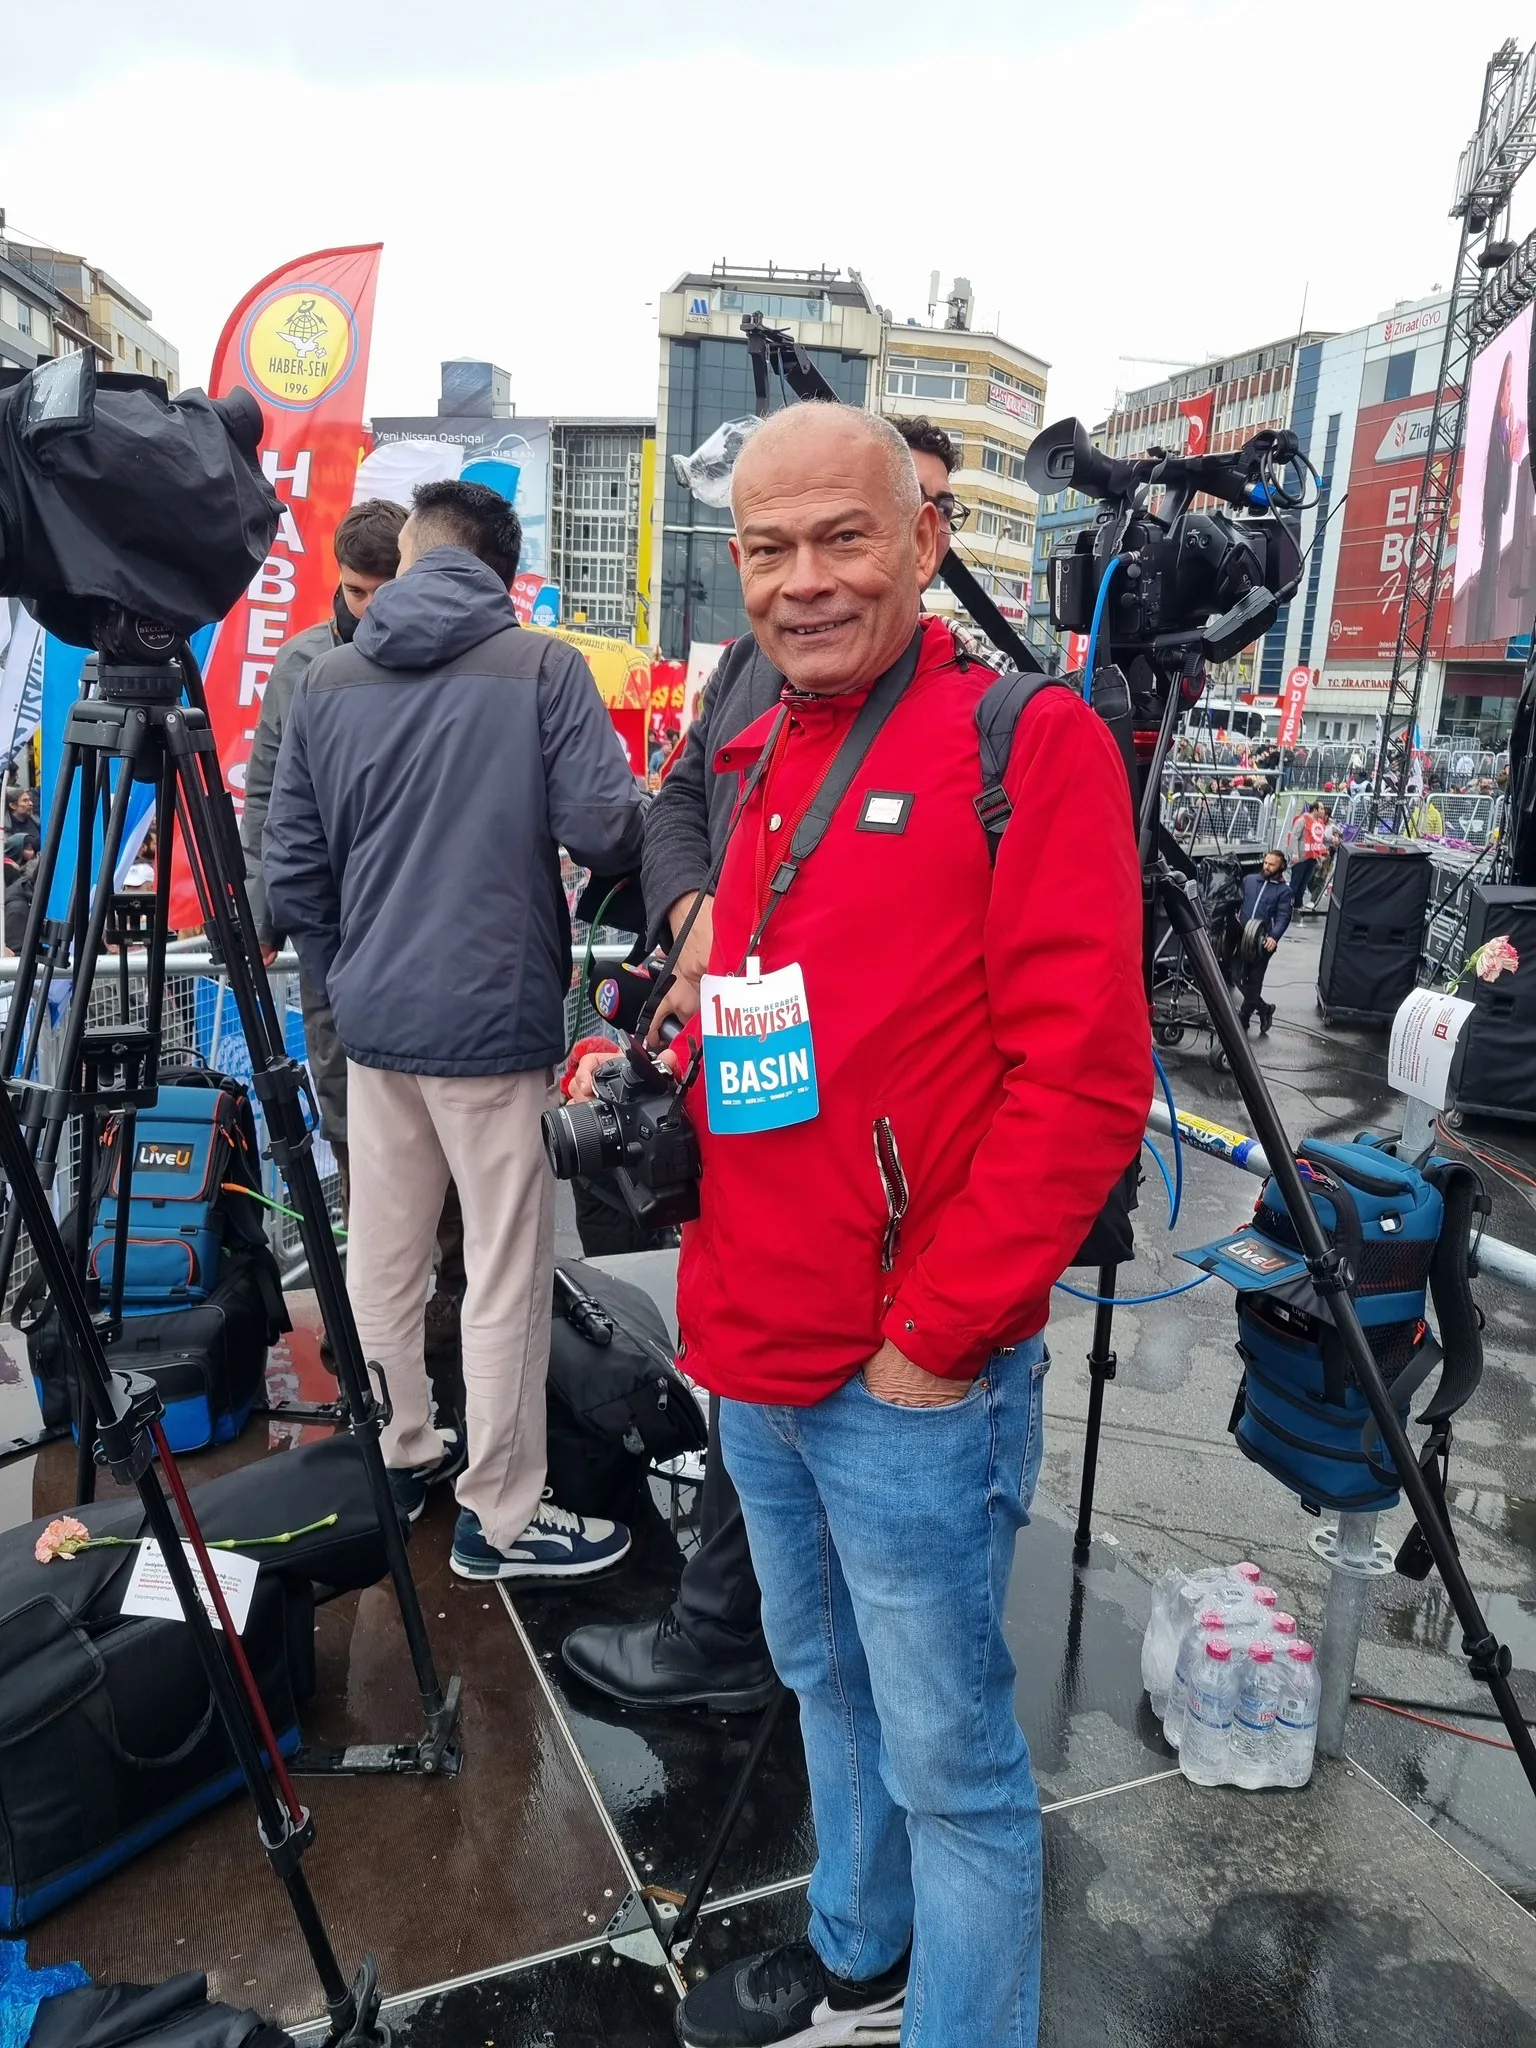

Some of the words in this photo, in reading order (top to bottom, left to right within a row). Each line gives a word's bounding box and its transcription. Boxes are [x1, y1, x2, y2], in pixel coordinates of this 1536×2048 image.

[1394, 318, 1419, 335] Ziraat
[1422, 310, 1441, 328] GYO
[269, 357, 328, 377] HABER-SEN
[284, 382, 308, 395] 1996
[376, 431, 399, 441] Yeni
[401, 432, 437, 442] Nissan
[439, 433, 484, 444] Qashqai
[492, 450, 535, 458] NISSAN
[1342, 676, 1370, 689] ZİRAAT
[1281, 690, 1302, 742] DİSK
[600, 983, 615, 1014] SZC
[743, 1006, 760, 1014] HEP
[764, 995, 799, 1012] BERABER
[712, 994, 723, 1036] 1
[720, 1048, 809, 1094] BASIN
[140, 1145, 190, 1166] LiveU
[1227, 1240, 1287, 1271] LiveU
